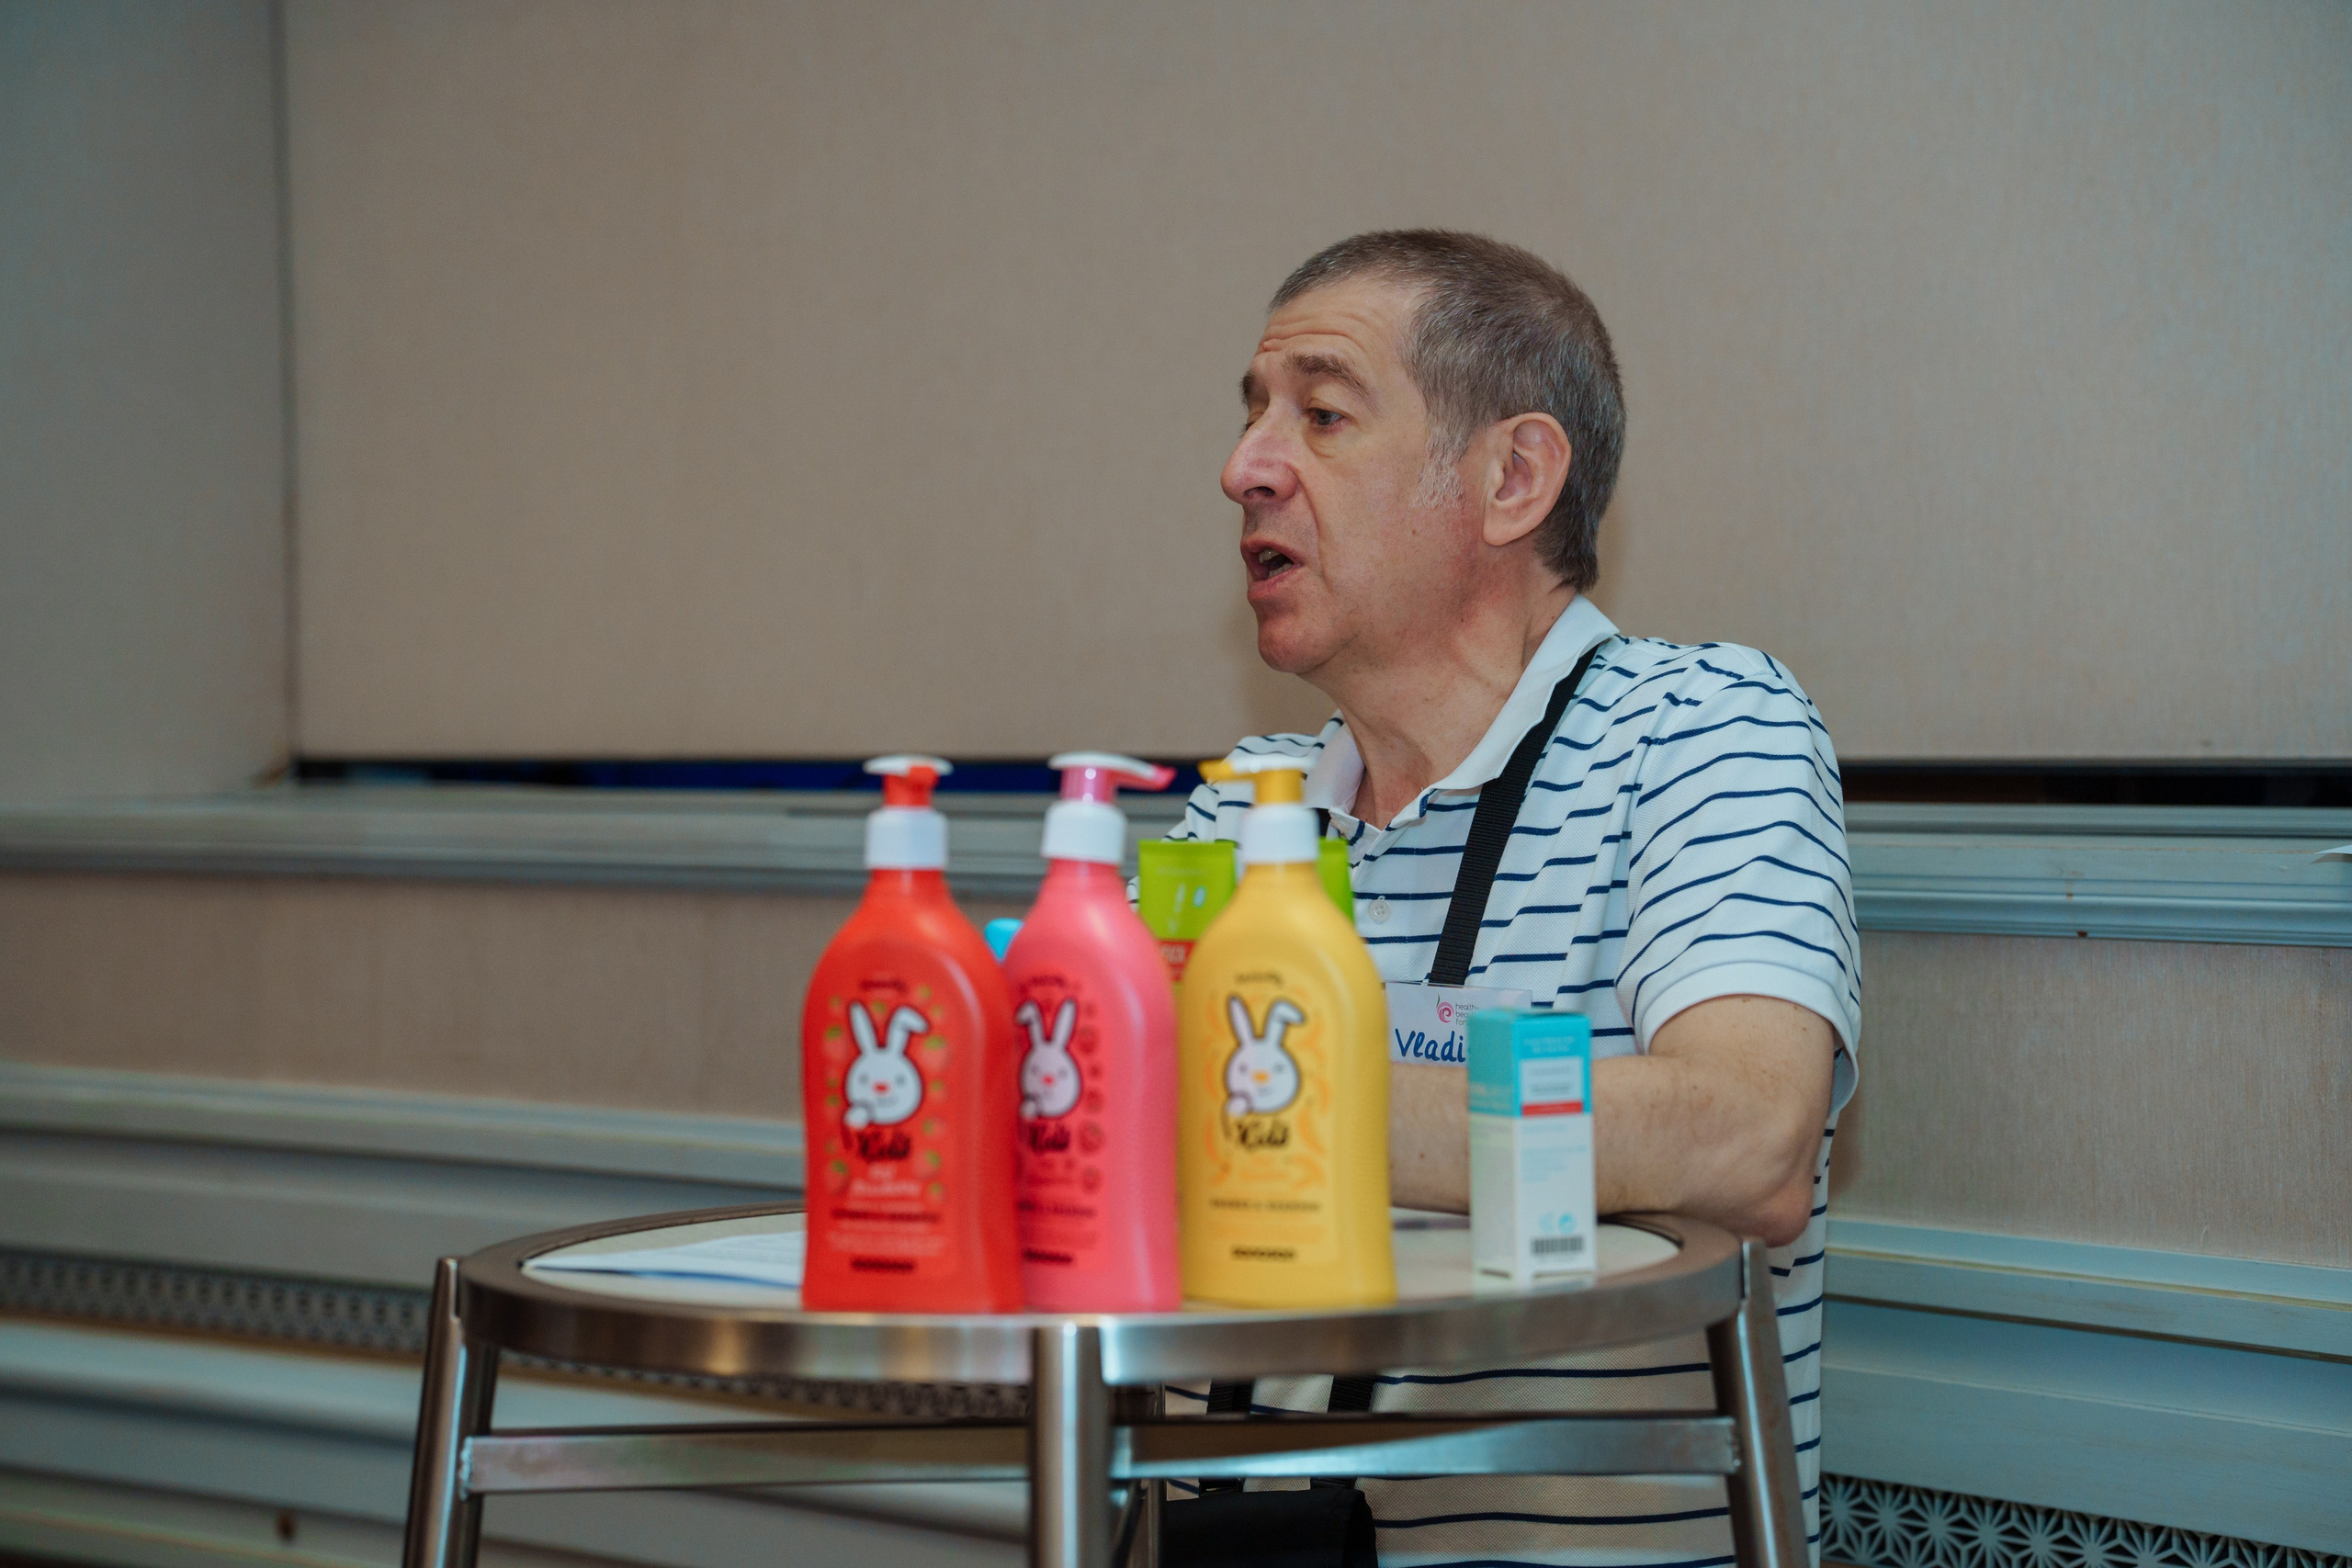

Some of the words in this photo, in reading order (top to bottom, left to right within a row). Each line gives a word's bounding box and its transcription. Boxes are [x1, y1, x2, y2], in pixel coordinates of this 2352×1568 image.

[1455, 1010, 1470, 1019] bea
[1455, 1018, 1467, 1026] for
[1395, 1028, 1466, 1063] Vladi
